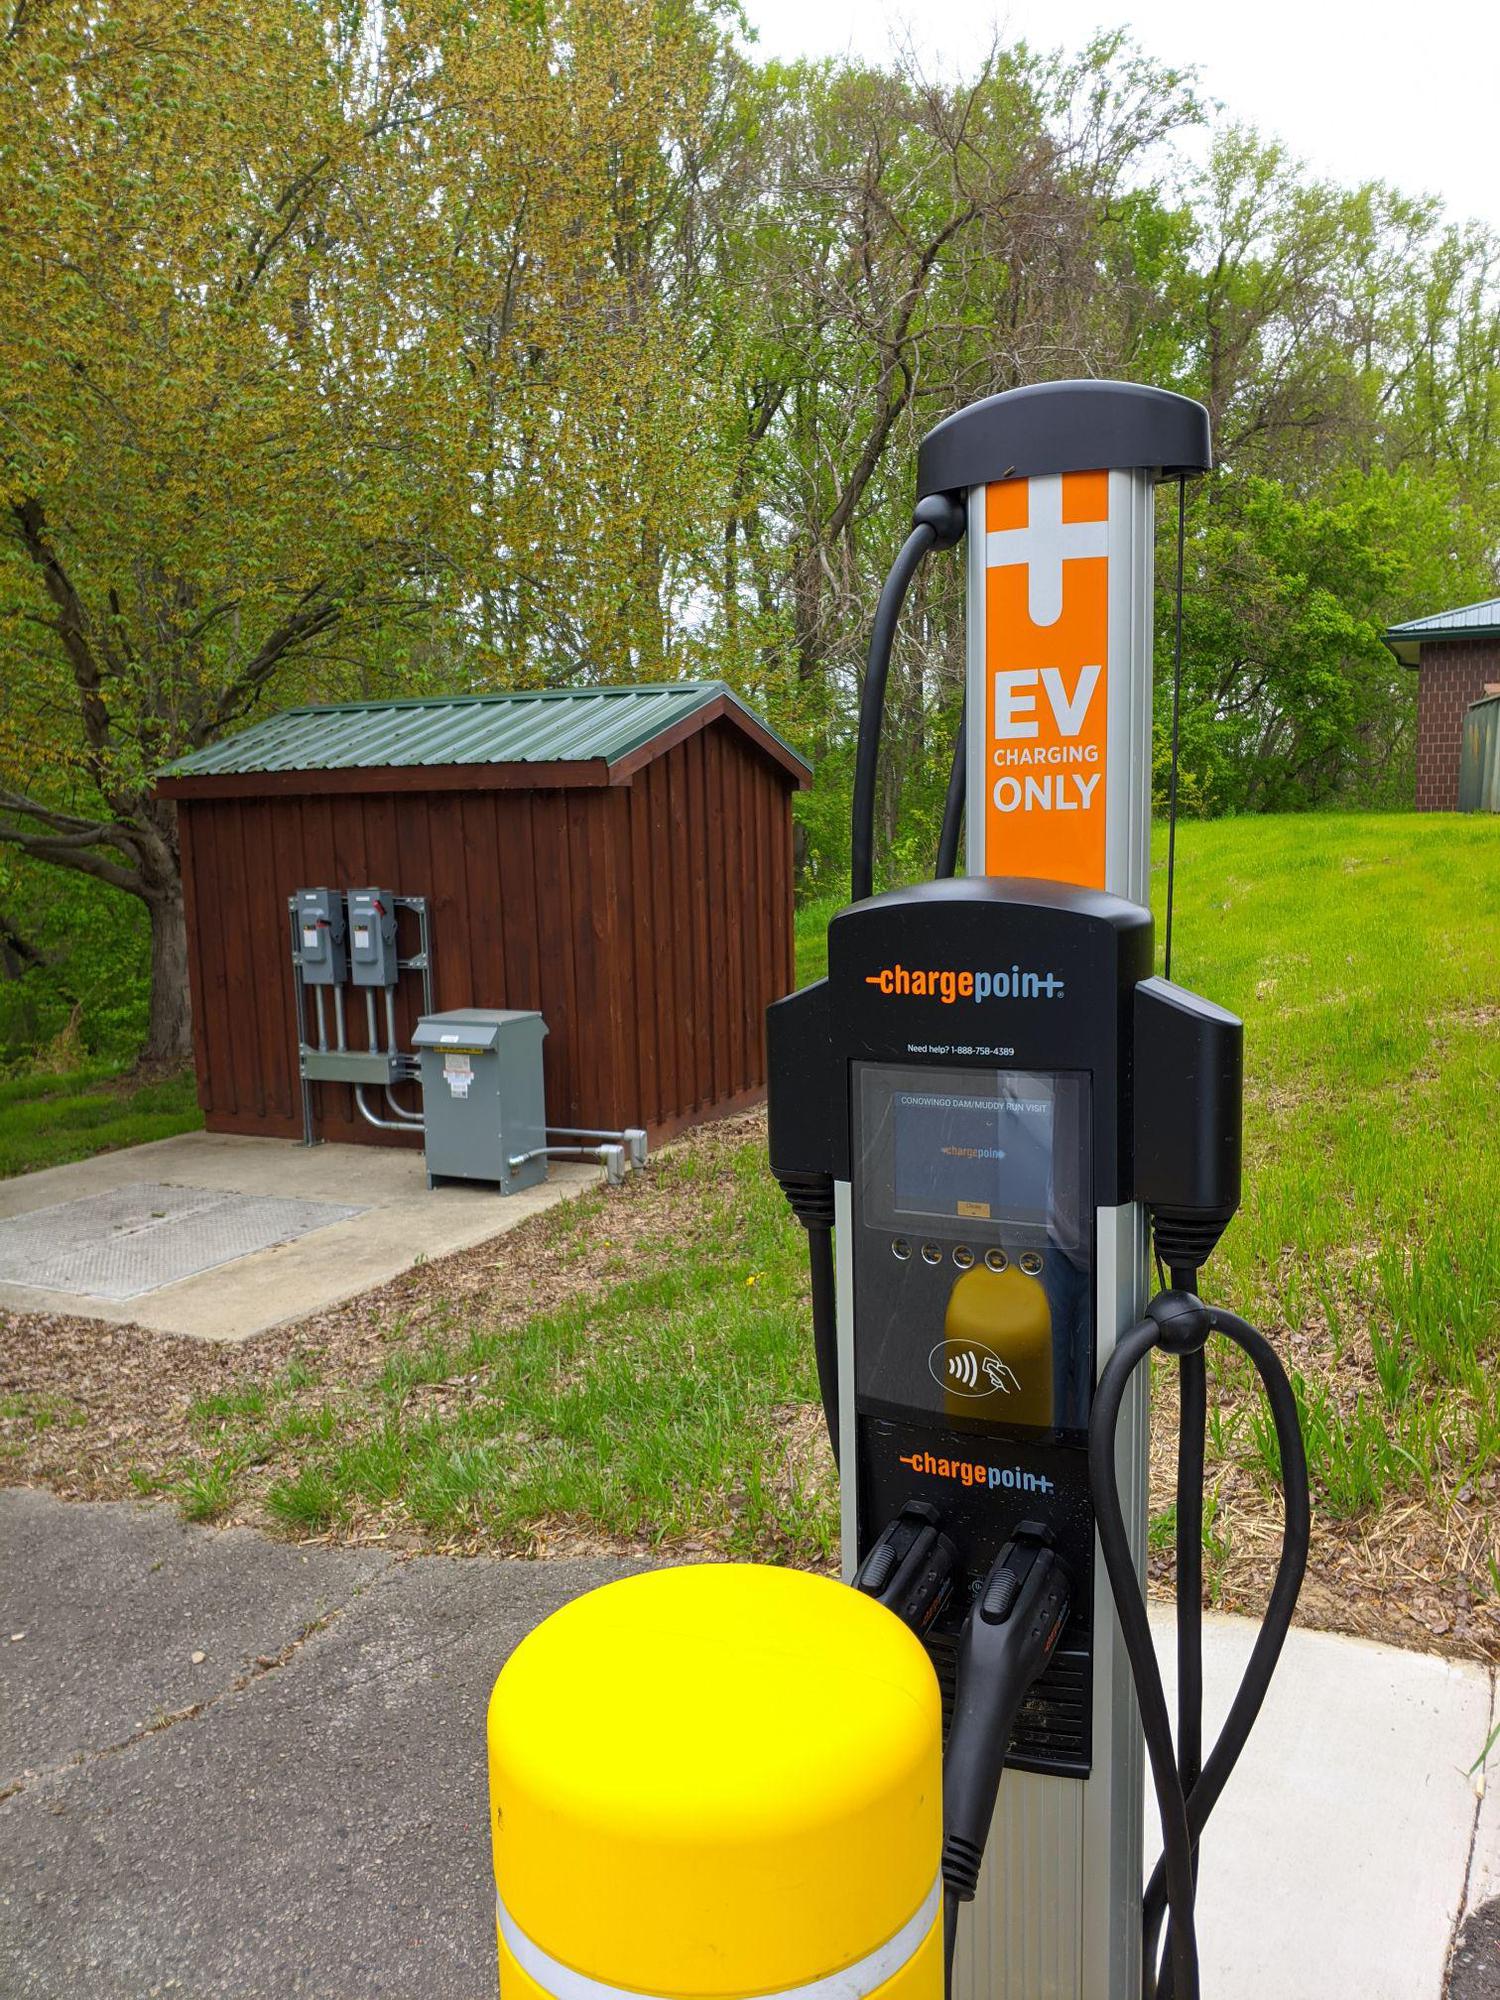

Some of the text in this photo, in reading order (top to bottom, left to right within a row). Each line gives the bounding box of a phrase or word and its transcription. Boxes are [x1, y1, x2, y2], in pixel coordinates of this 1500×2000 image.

[994, 665, 1102, 740] EV
[993, 744, 1099, 767] CHARGING
[993, 774, 1102, 813] ONLY
[907, 1043, 1015, 1056] Need help? 1-888-758-4389
[1006, 1102, 1024, 1112] RUN
[1026, 1104, 1048, 1113] VISIT
